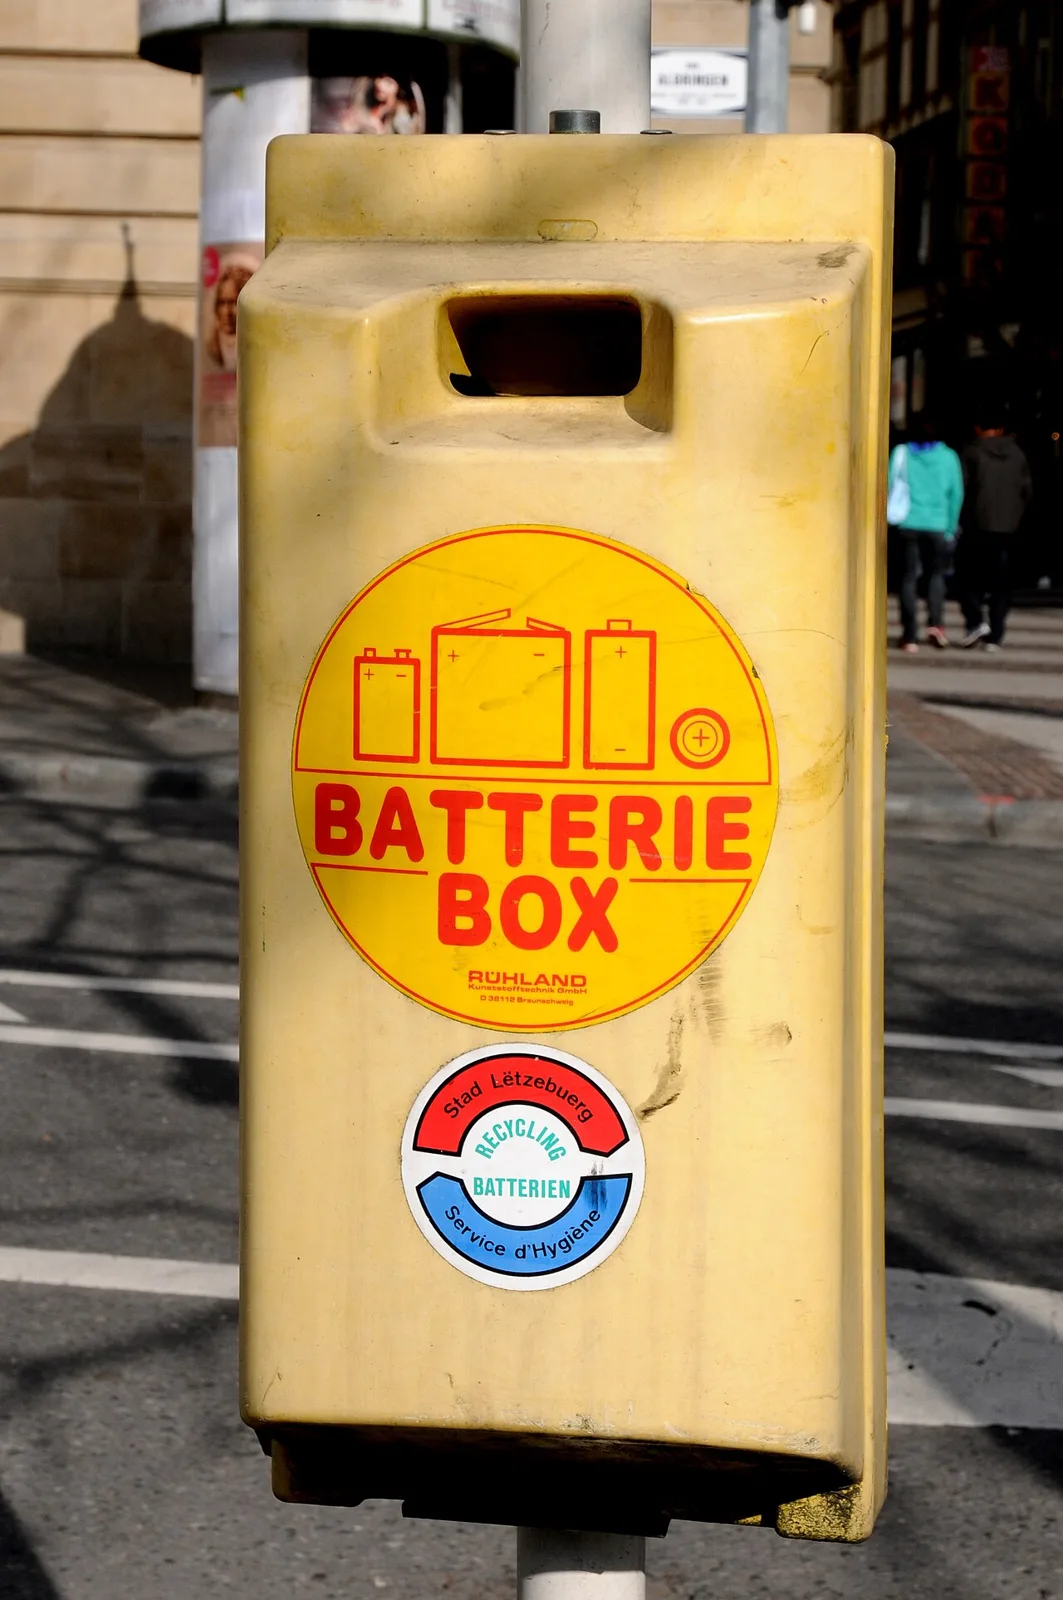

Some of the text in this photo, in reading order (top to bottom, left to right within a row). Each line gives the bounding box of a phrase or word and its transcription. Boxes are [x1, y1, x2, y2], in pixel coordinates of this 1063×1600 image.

[314, 782, 753, 871] BATTERIE
[437, 872, 618, 953] BOX
[468, 970, 587, 987] RÜHLAND
[468, 984, 555, 994] Kunststofftechnik
[488, 995, 515, 1003] 38112
[517, 997, 574, 1006] Braunschweig
[443, 1071, 594, 1124] Stad Lëtzebuerg
[474, 1118, 567, 1161] RECYCLING
[473, 1177, 570, 1199] BATTERIEN
[444, 1205, 601, 1259] Service d'Hygiène
